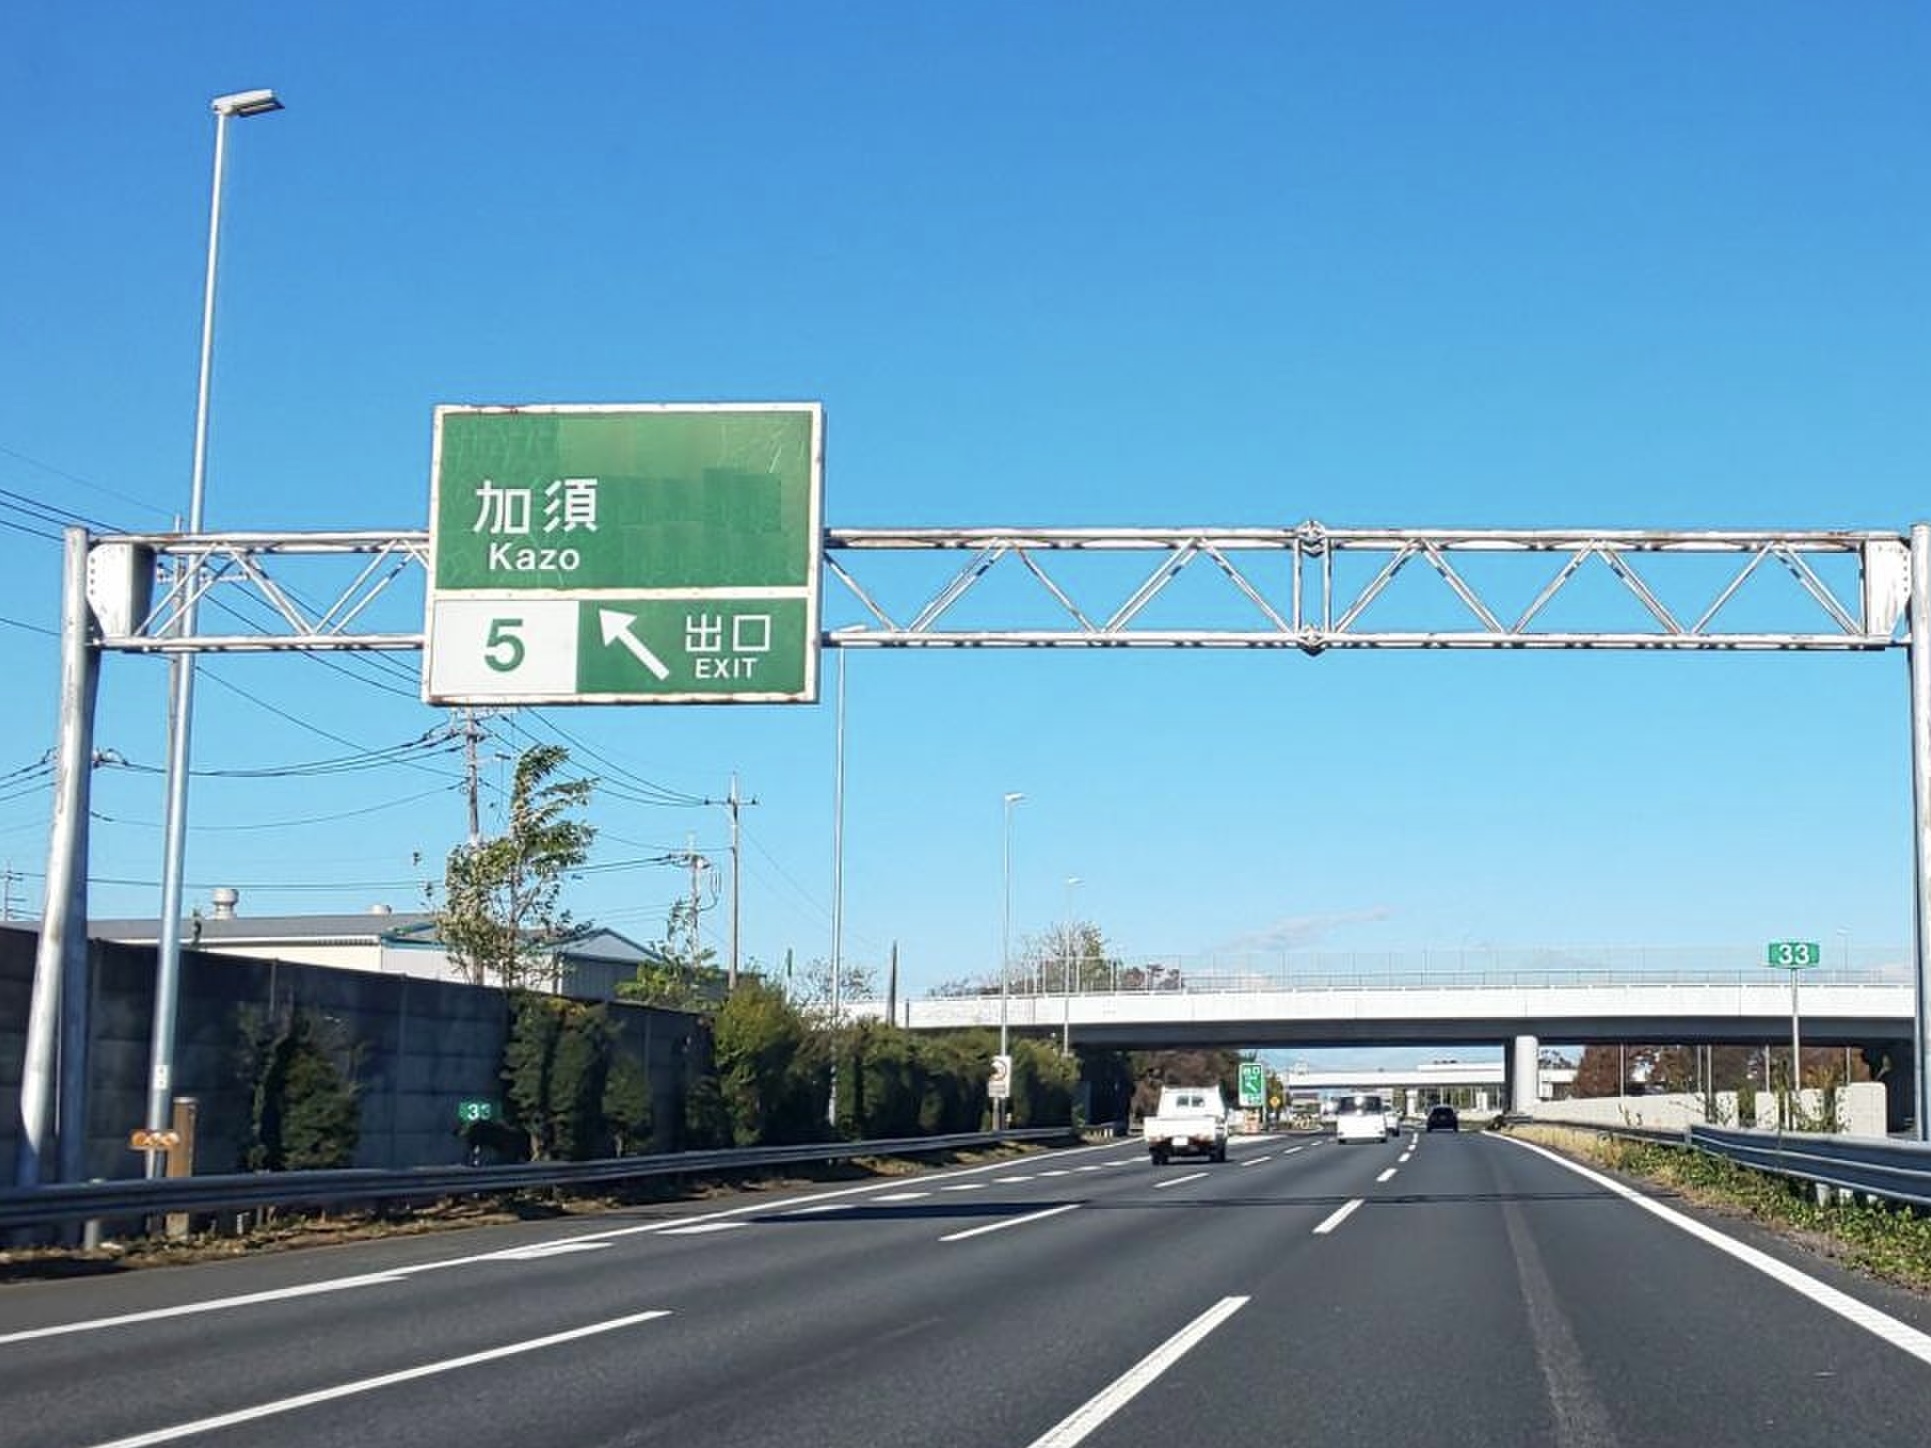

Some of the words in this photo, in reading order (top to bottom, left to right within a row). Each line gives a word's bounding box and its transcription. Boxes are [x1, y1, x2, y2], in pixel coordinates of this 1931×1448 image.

[473, 478, 598, 534] 加須
[488, 543, 580, 570] Kazo
[484, 618, 526, 672] 5
[685, 613, 771, 652] 出口
[695, 658, 758, 678] EXIT
[1779, 944, 1810, 965] 33
[467, 1103, 491, 1120] 33
